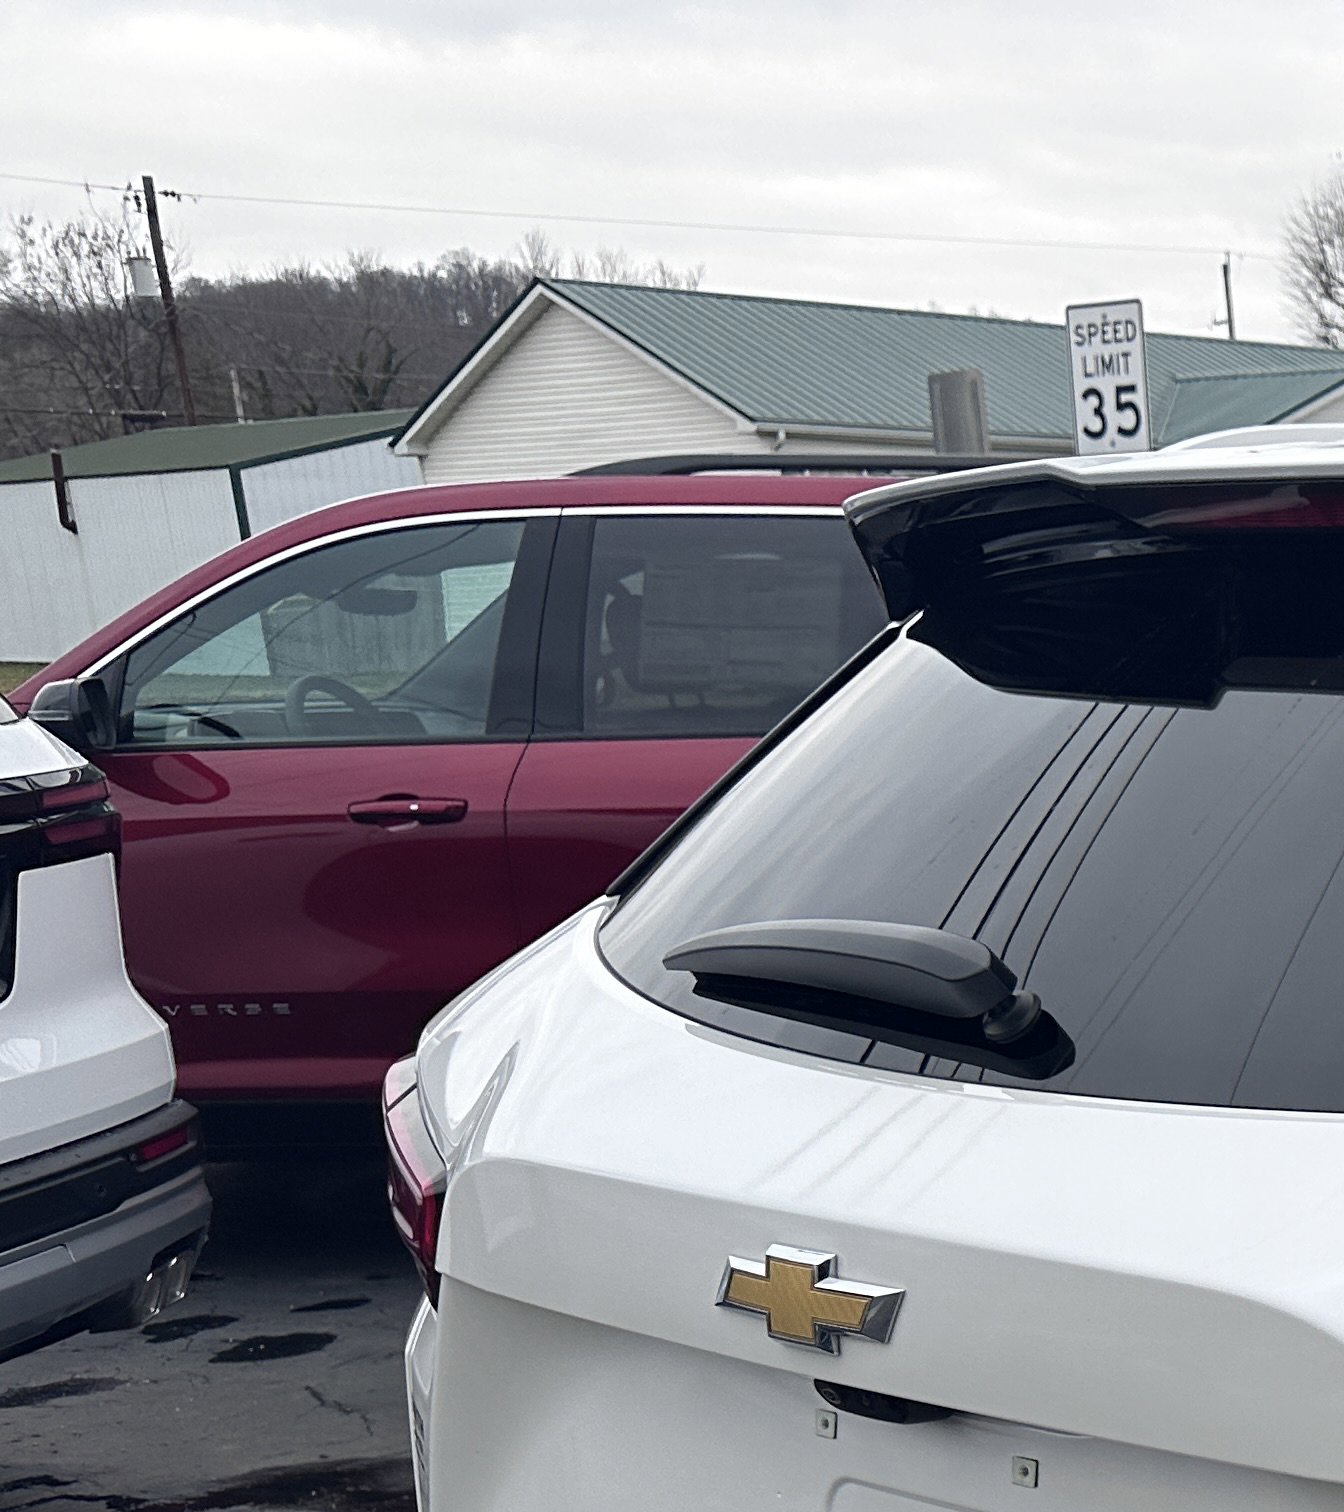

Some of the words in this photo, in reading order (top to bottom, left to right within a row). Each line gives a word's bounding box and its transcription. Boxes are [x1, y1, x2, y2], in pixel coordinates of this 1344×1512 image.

[1074, 320, 1137, 346] SPEED
[1081, 351, 1131, 378] LIMIT
[1081, 384, 1141, 440] 35
